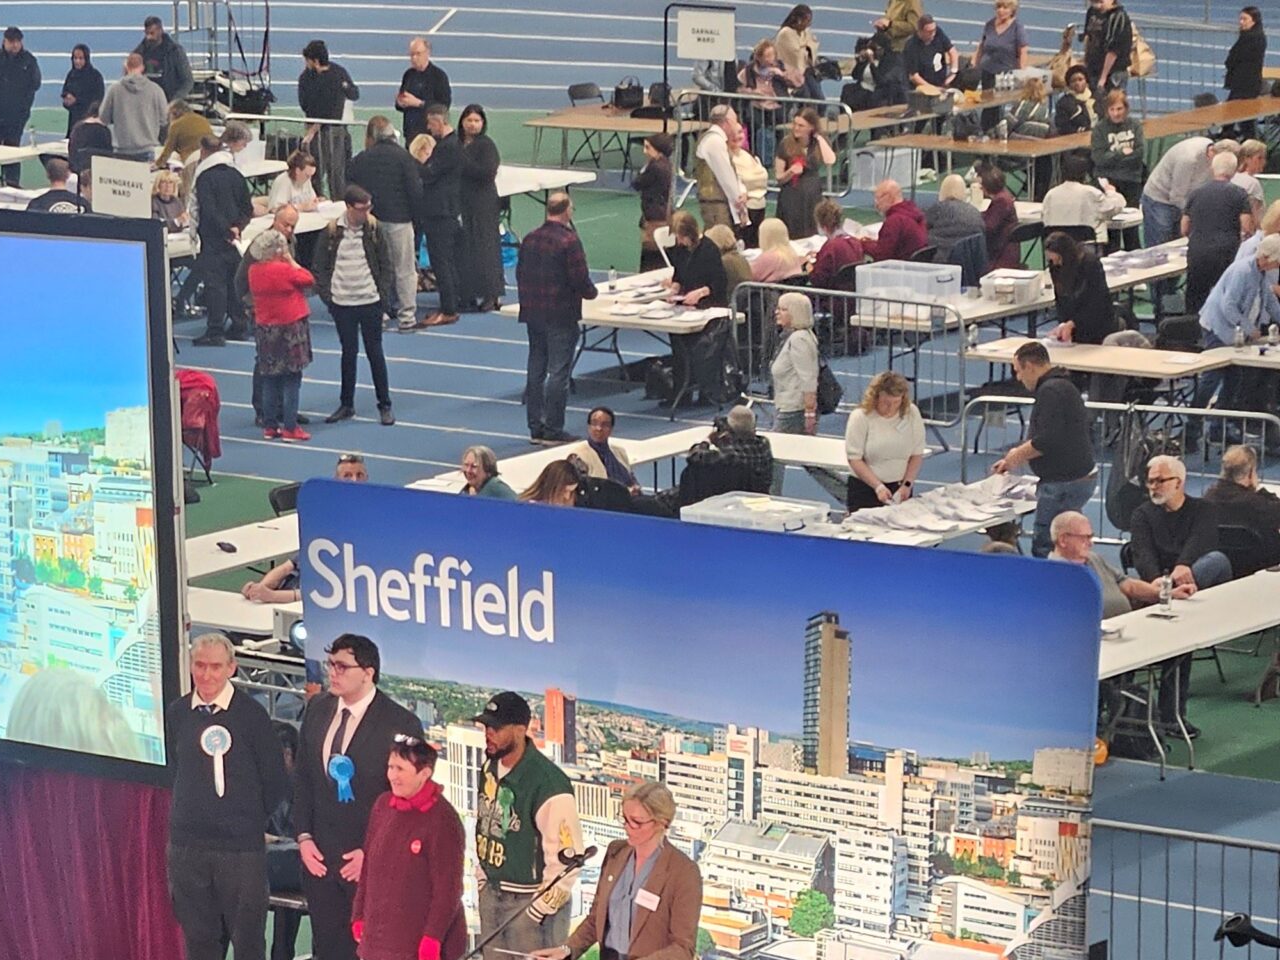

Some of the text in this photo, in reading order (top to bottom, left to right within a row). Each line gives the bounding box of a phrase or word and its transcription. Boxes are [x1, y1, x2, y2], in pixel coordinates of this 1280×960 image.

[98, 176, 144, 190] BURNGREAVE
[111, 188, 131, 198] WARD
[307, 537, 555, 643] Sheffield
